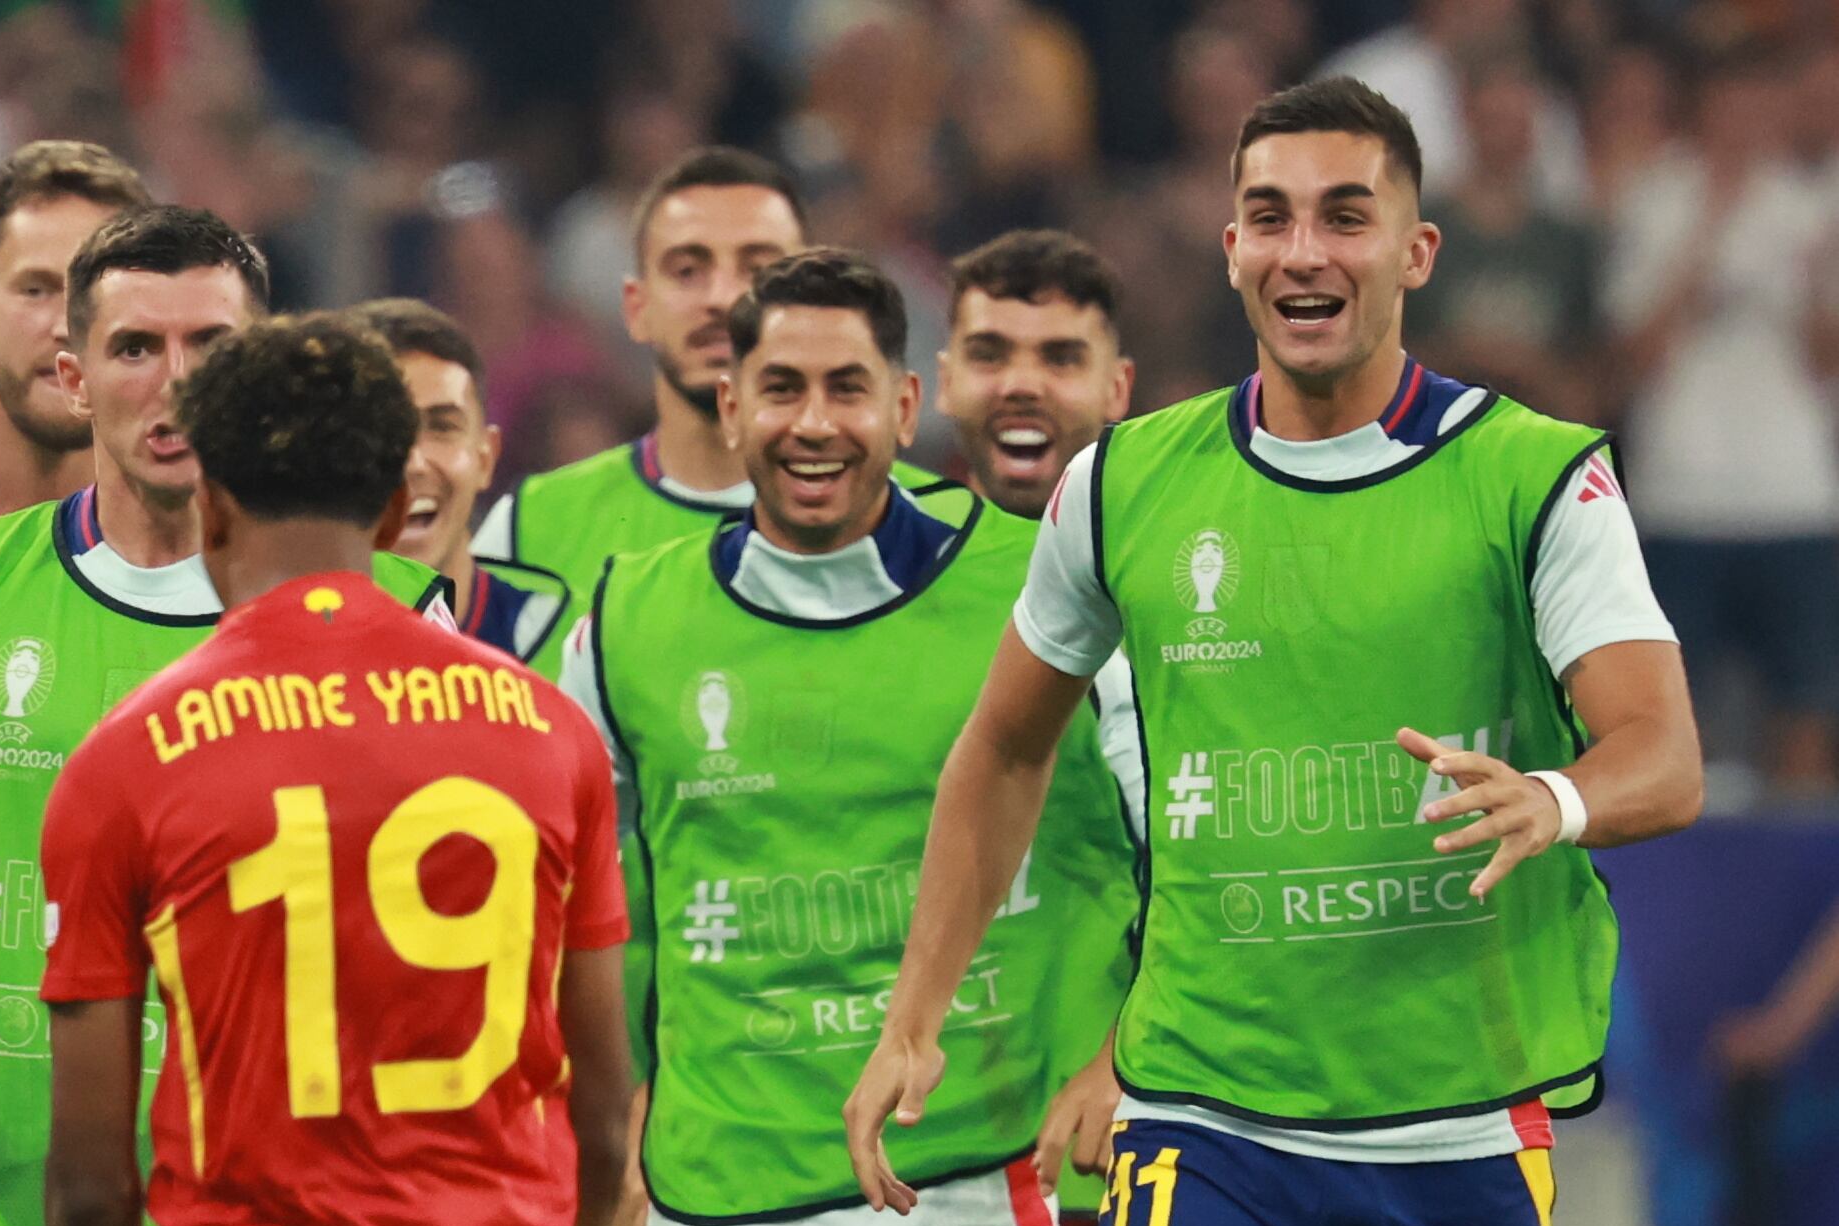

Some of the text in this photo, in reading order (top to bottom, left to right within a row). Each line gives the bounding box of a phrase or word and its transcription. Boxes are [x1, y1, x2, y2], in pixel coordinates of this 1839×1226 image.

[1160, 641, 1263, 663] EURO2024
[145, 664, 552, 764] LAMINE YAMAL
[1164, 717, 1513, 840] #FOOTBA
[227, 776, 539, 1118] 19
